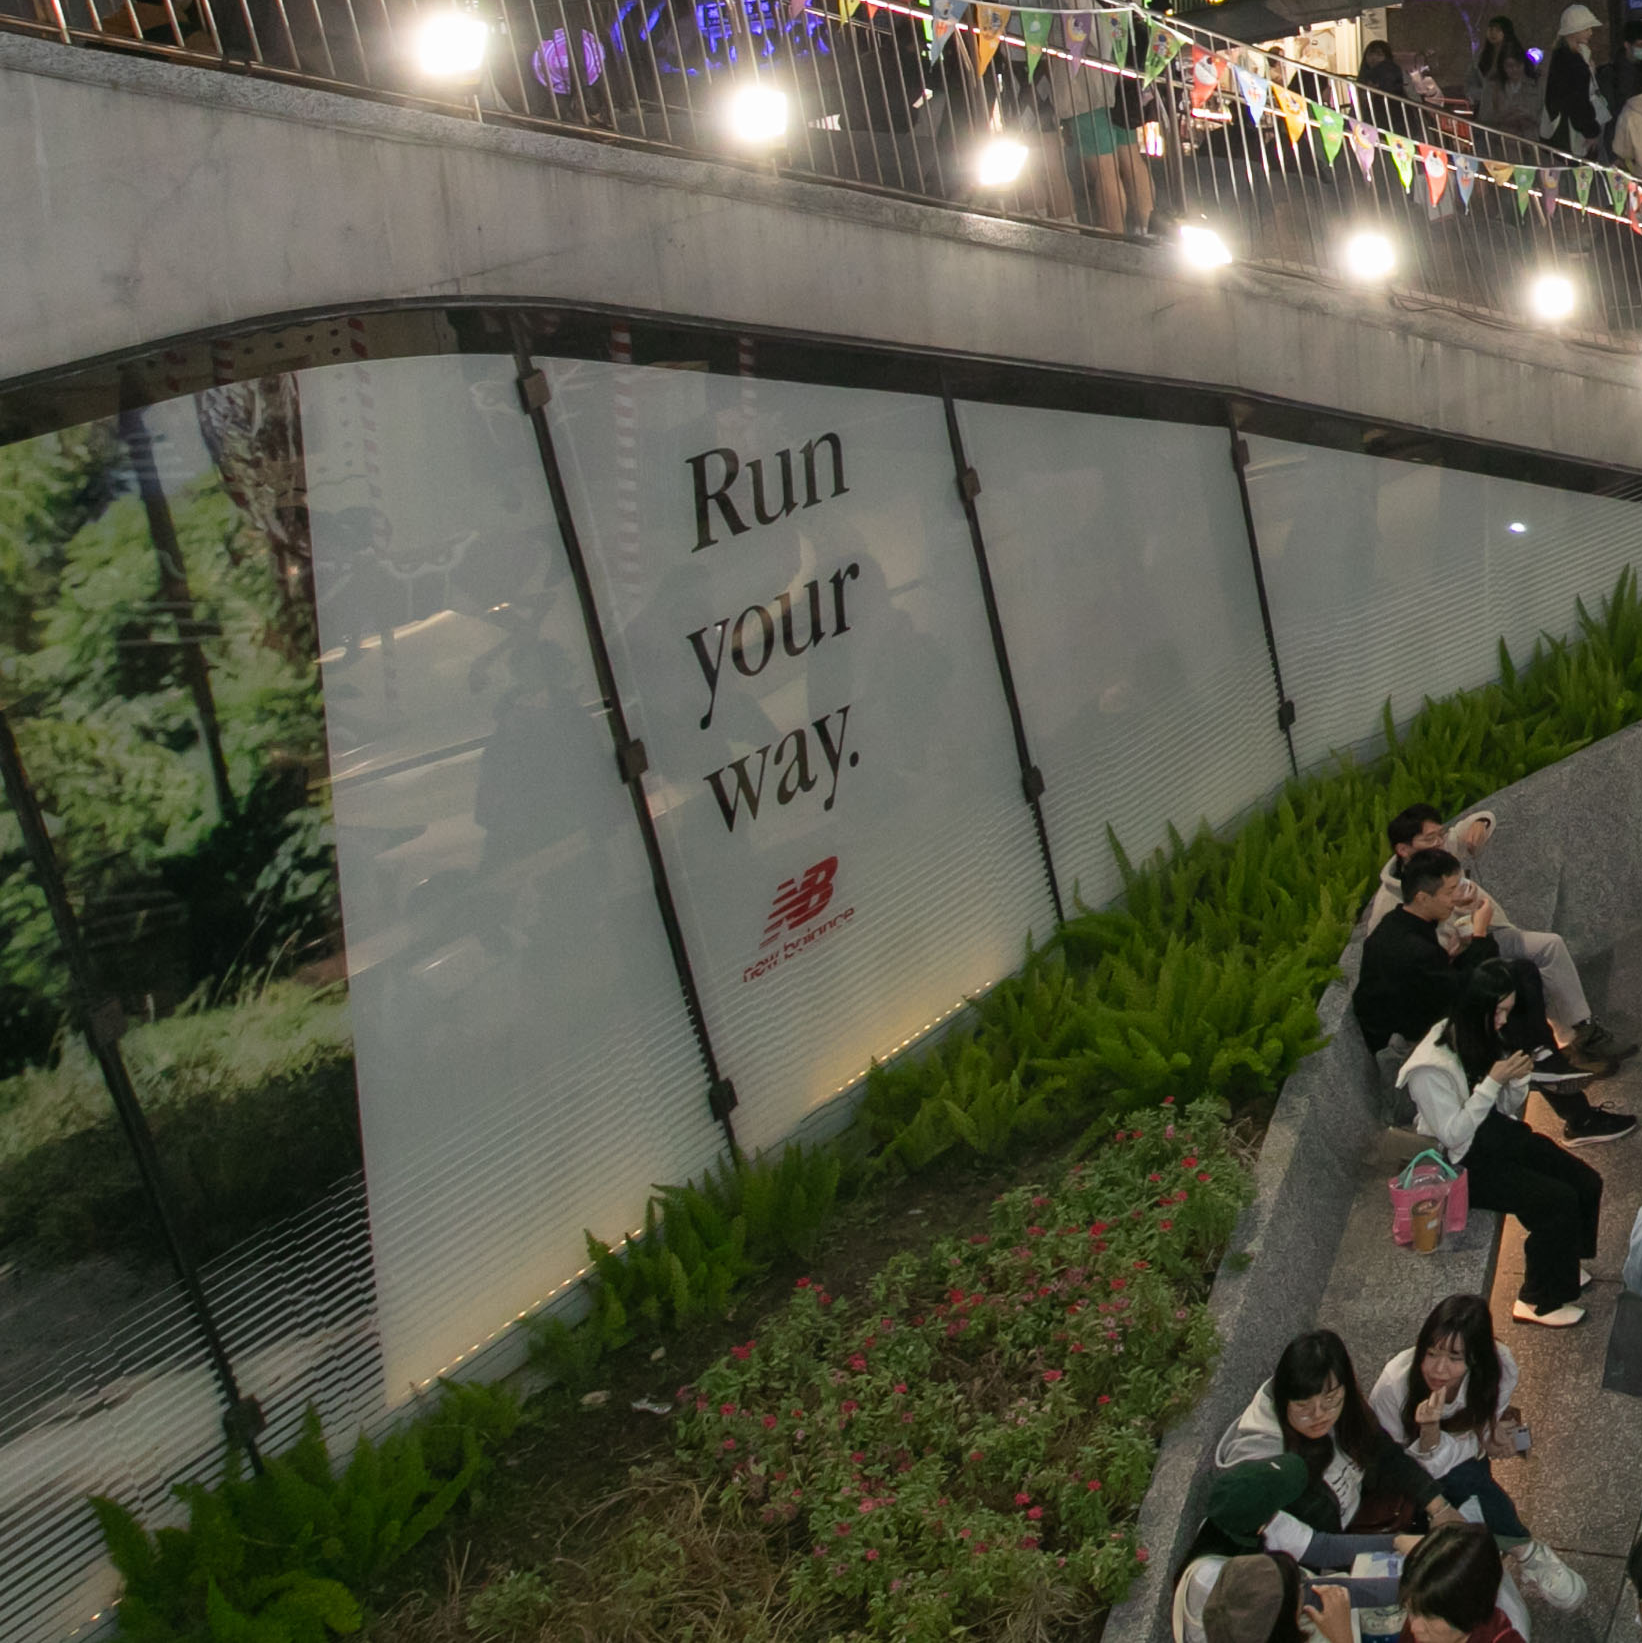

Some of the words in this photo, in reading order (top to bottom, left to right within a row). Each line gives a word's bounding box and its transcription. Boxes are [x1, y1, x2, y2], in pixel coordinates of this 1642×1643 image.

[686, 430, 850, 553] Run
[686, 561, 860, 731] your
[704, 704, 859, 834] way.
